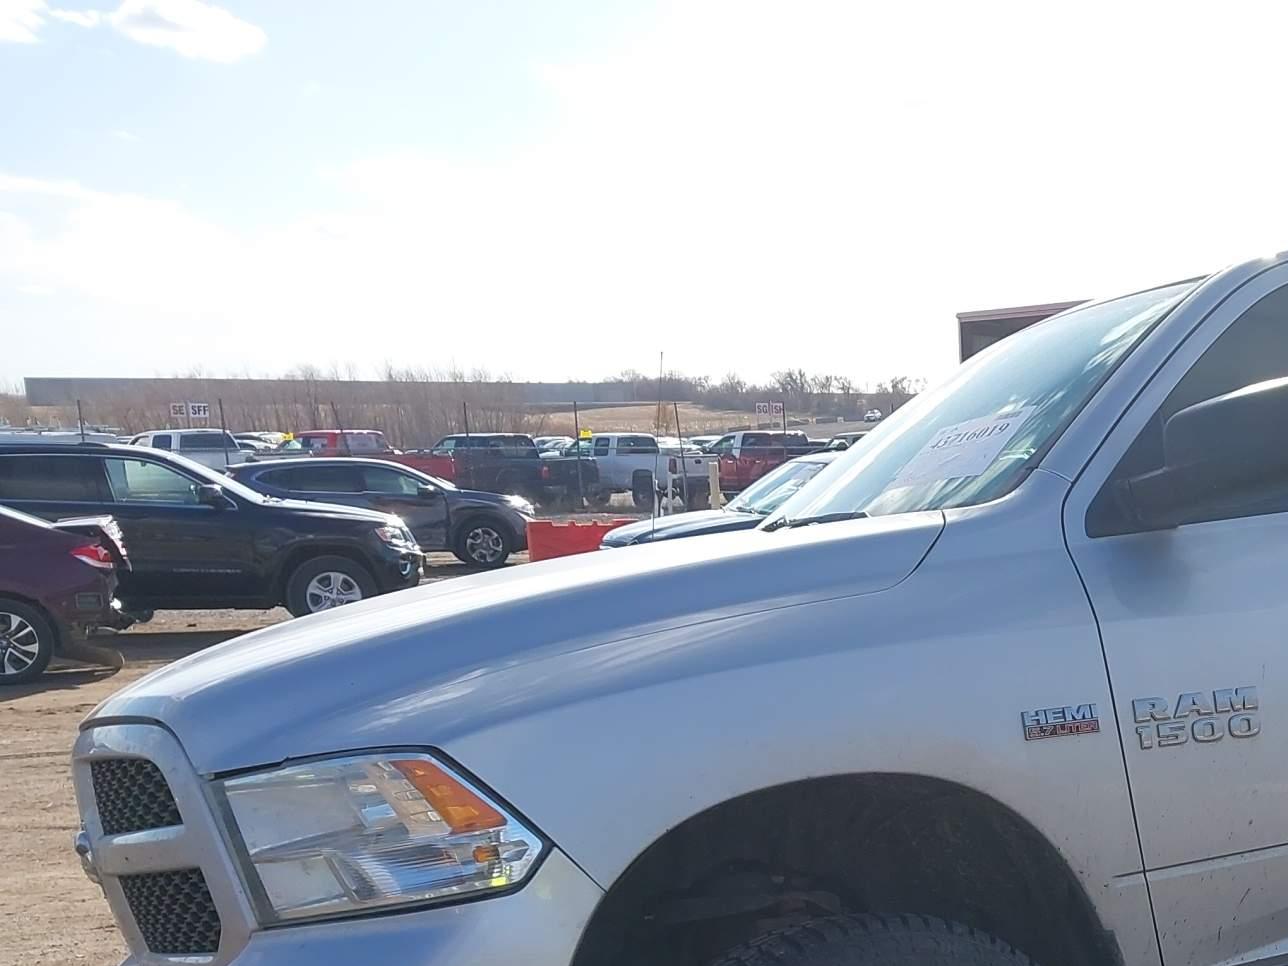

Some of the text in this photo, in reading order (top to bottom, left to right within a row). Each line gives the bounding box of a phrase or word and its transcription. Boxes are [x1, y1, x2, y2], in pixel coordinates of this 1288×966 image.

[191, 404, 209, 416] SFF
[1020, 703, 1099, 727] HEMI
[1131, 685, 1259, 724] RAM
[1028, 725, 1056, 739] 5.7
[1135, 713, 1261, 750] 1500
